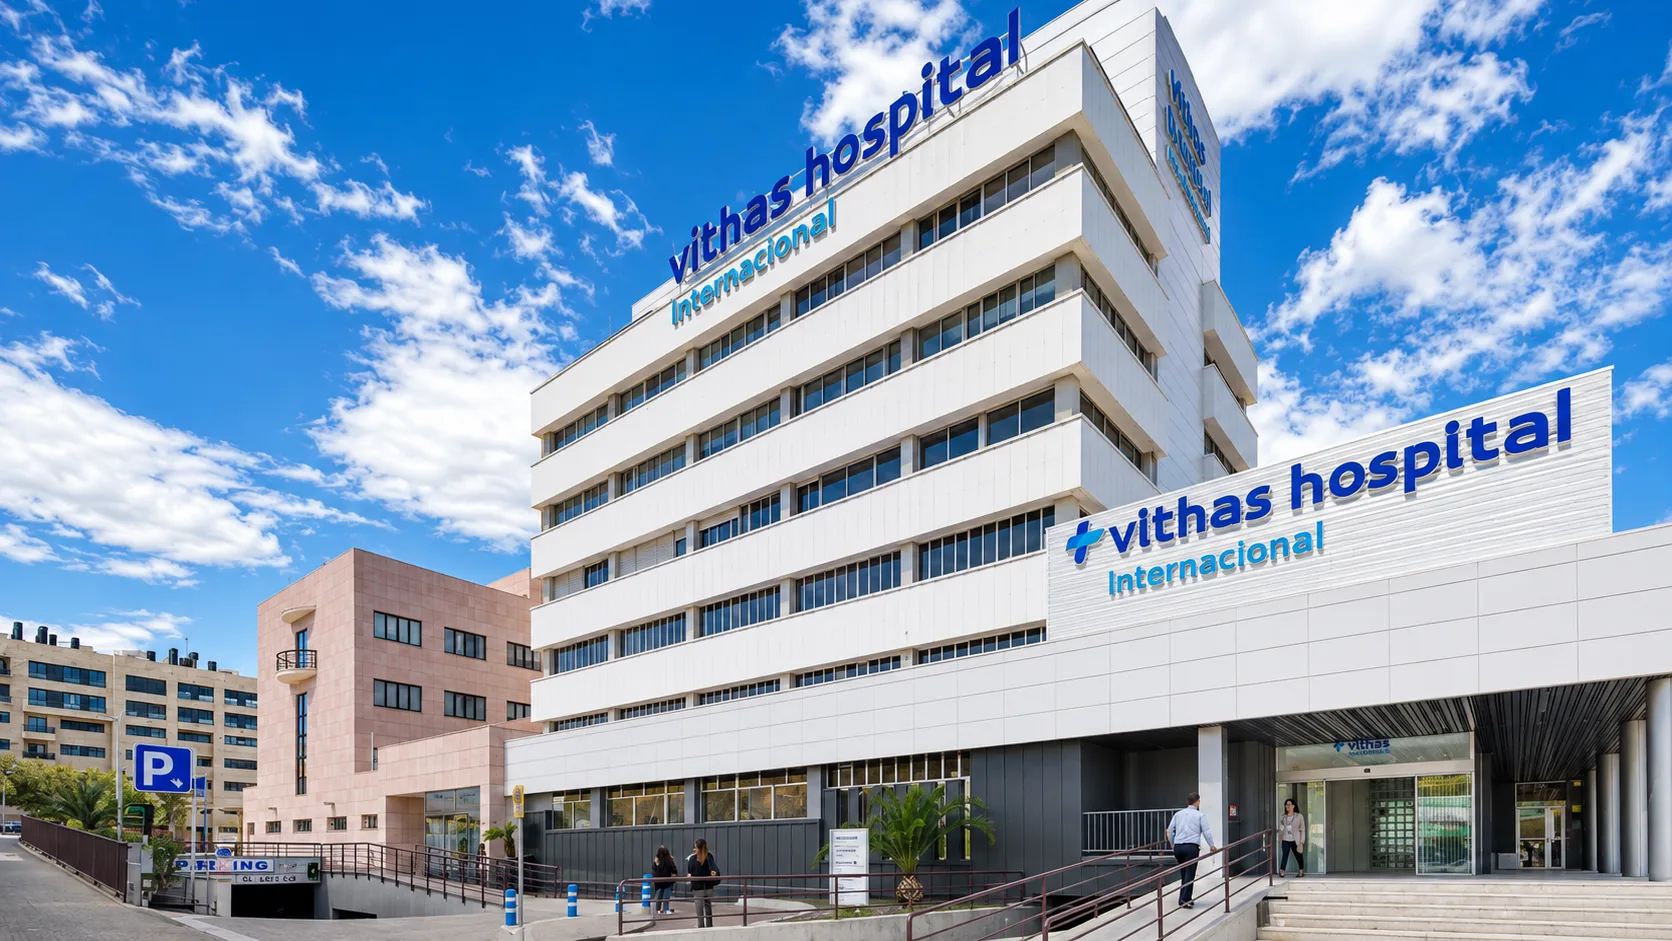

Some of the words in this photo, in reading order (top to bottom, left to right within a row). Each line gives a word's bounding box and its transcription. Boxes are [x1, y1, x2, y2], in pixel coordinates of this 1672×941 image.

[669, 175, 792, 284] vithas
[806, 7, 1020, 197] hospital
[671, 197, 836, 326] Internacional
[1109, 485, 1272, 553] vithas
[1291, 387, 1571, 510] hospital
[1108, 520, 1324, 595] Internacional
[143, 750, 174, 786] P
